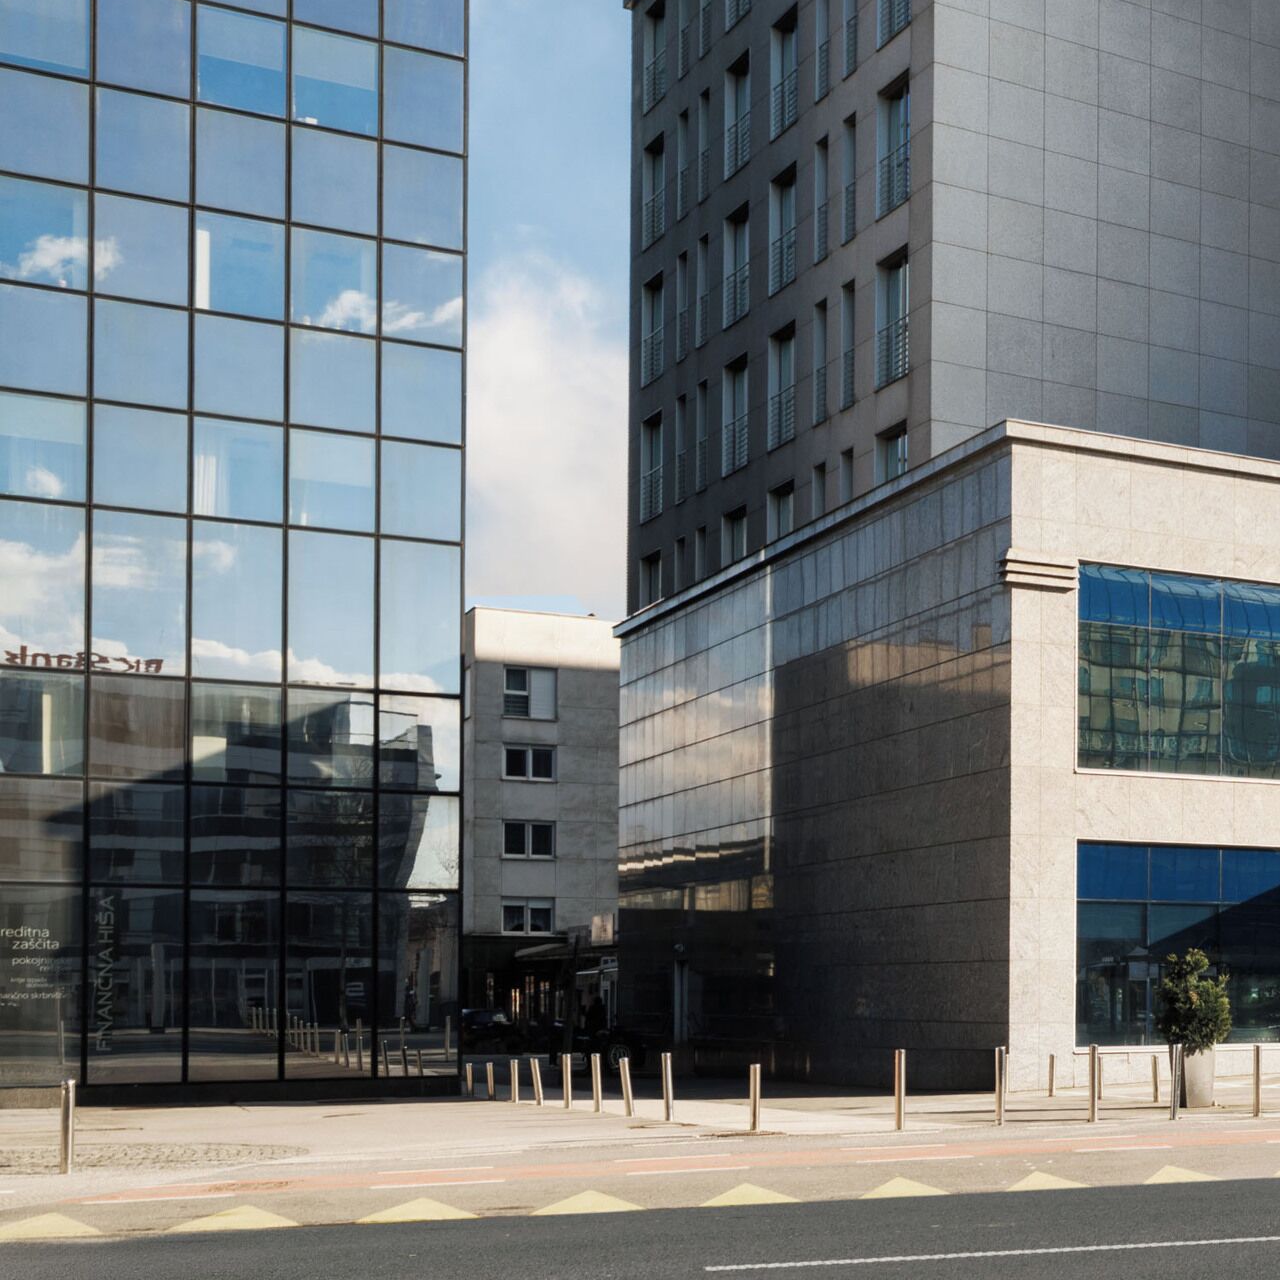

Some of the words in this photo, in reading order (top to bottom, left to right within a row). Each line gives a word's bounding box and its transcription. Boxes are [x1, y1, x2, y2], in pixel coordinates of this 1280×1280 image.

[95, 895, 114, 944] HIŠA
[12, 939, 60, 950] zaščita
[95, 947, 113, 1051] FINANČNA
